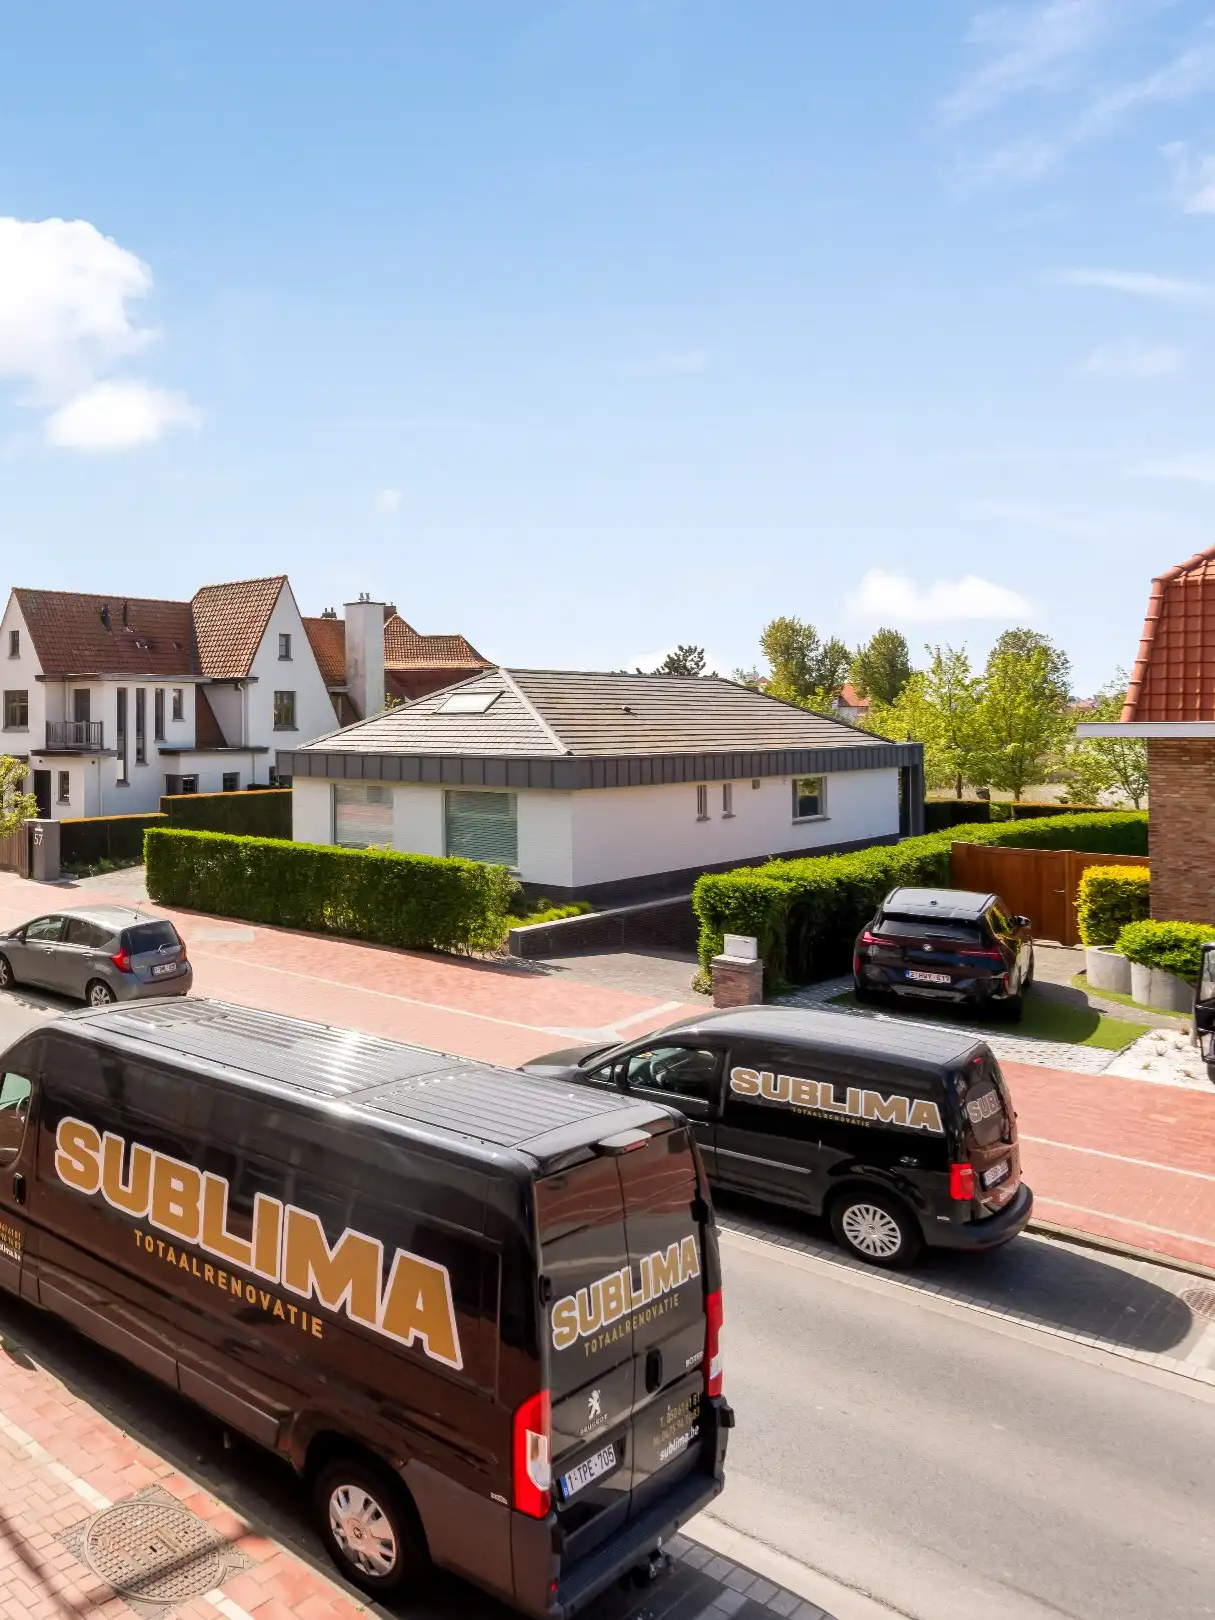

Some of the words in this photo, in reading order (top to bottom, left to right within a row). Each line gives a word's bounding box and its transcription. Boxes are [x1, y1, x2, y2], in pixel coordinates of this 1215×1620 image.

[34, 833, 44, 846] 57
[730, 1066, 944, 1133] SUBLIMA
[792, 1106, 871, 1128] TOTAALRENOVATIE
[55, 1115, 464, 1371] SUBLIMA
[134, 1229, 324, 1340] TOTAALRENOVATIE
[551, 1234, 700, 1352] SUBLIMA
[583, 1292, 681, 1358] TOTAALRENOVATIE
[579, 1412, 609, 1436] PEUGEOT
[659, 1425, 700, 1461] sublima.be
